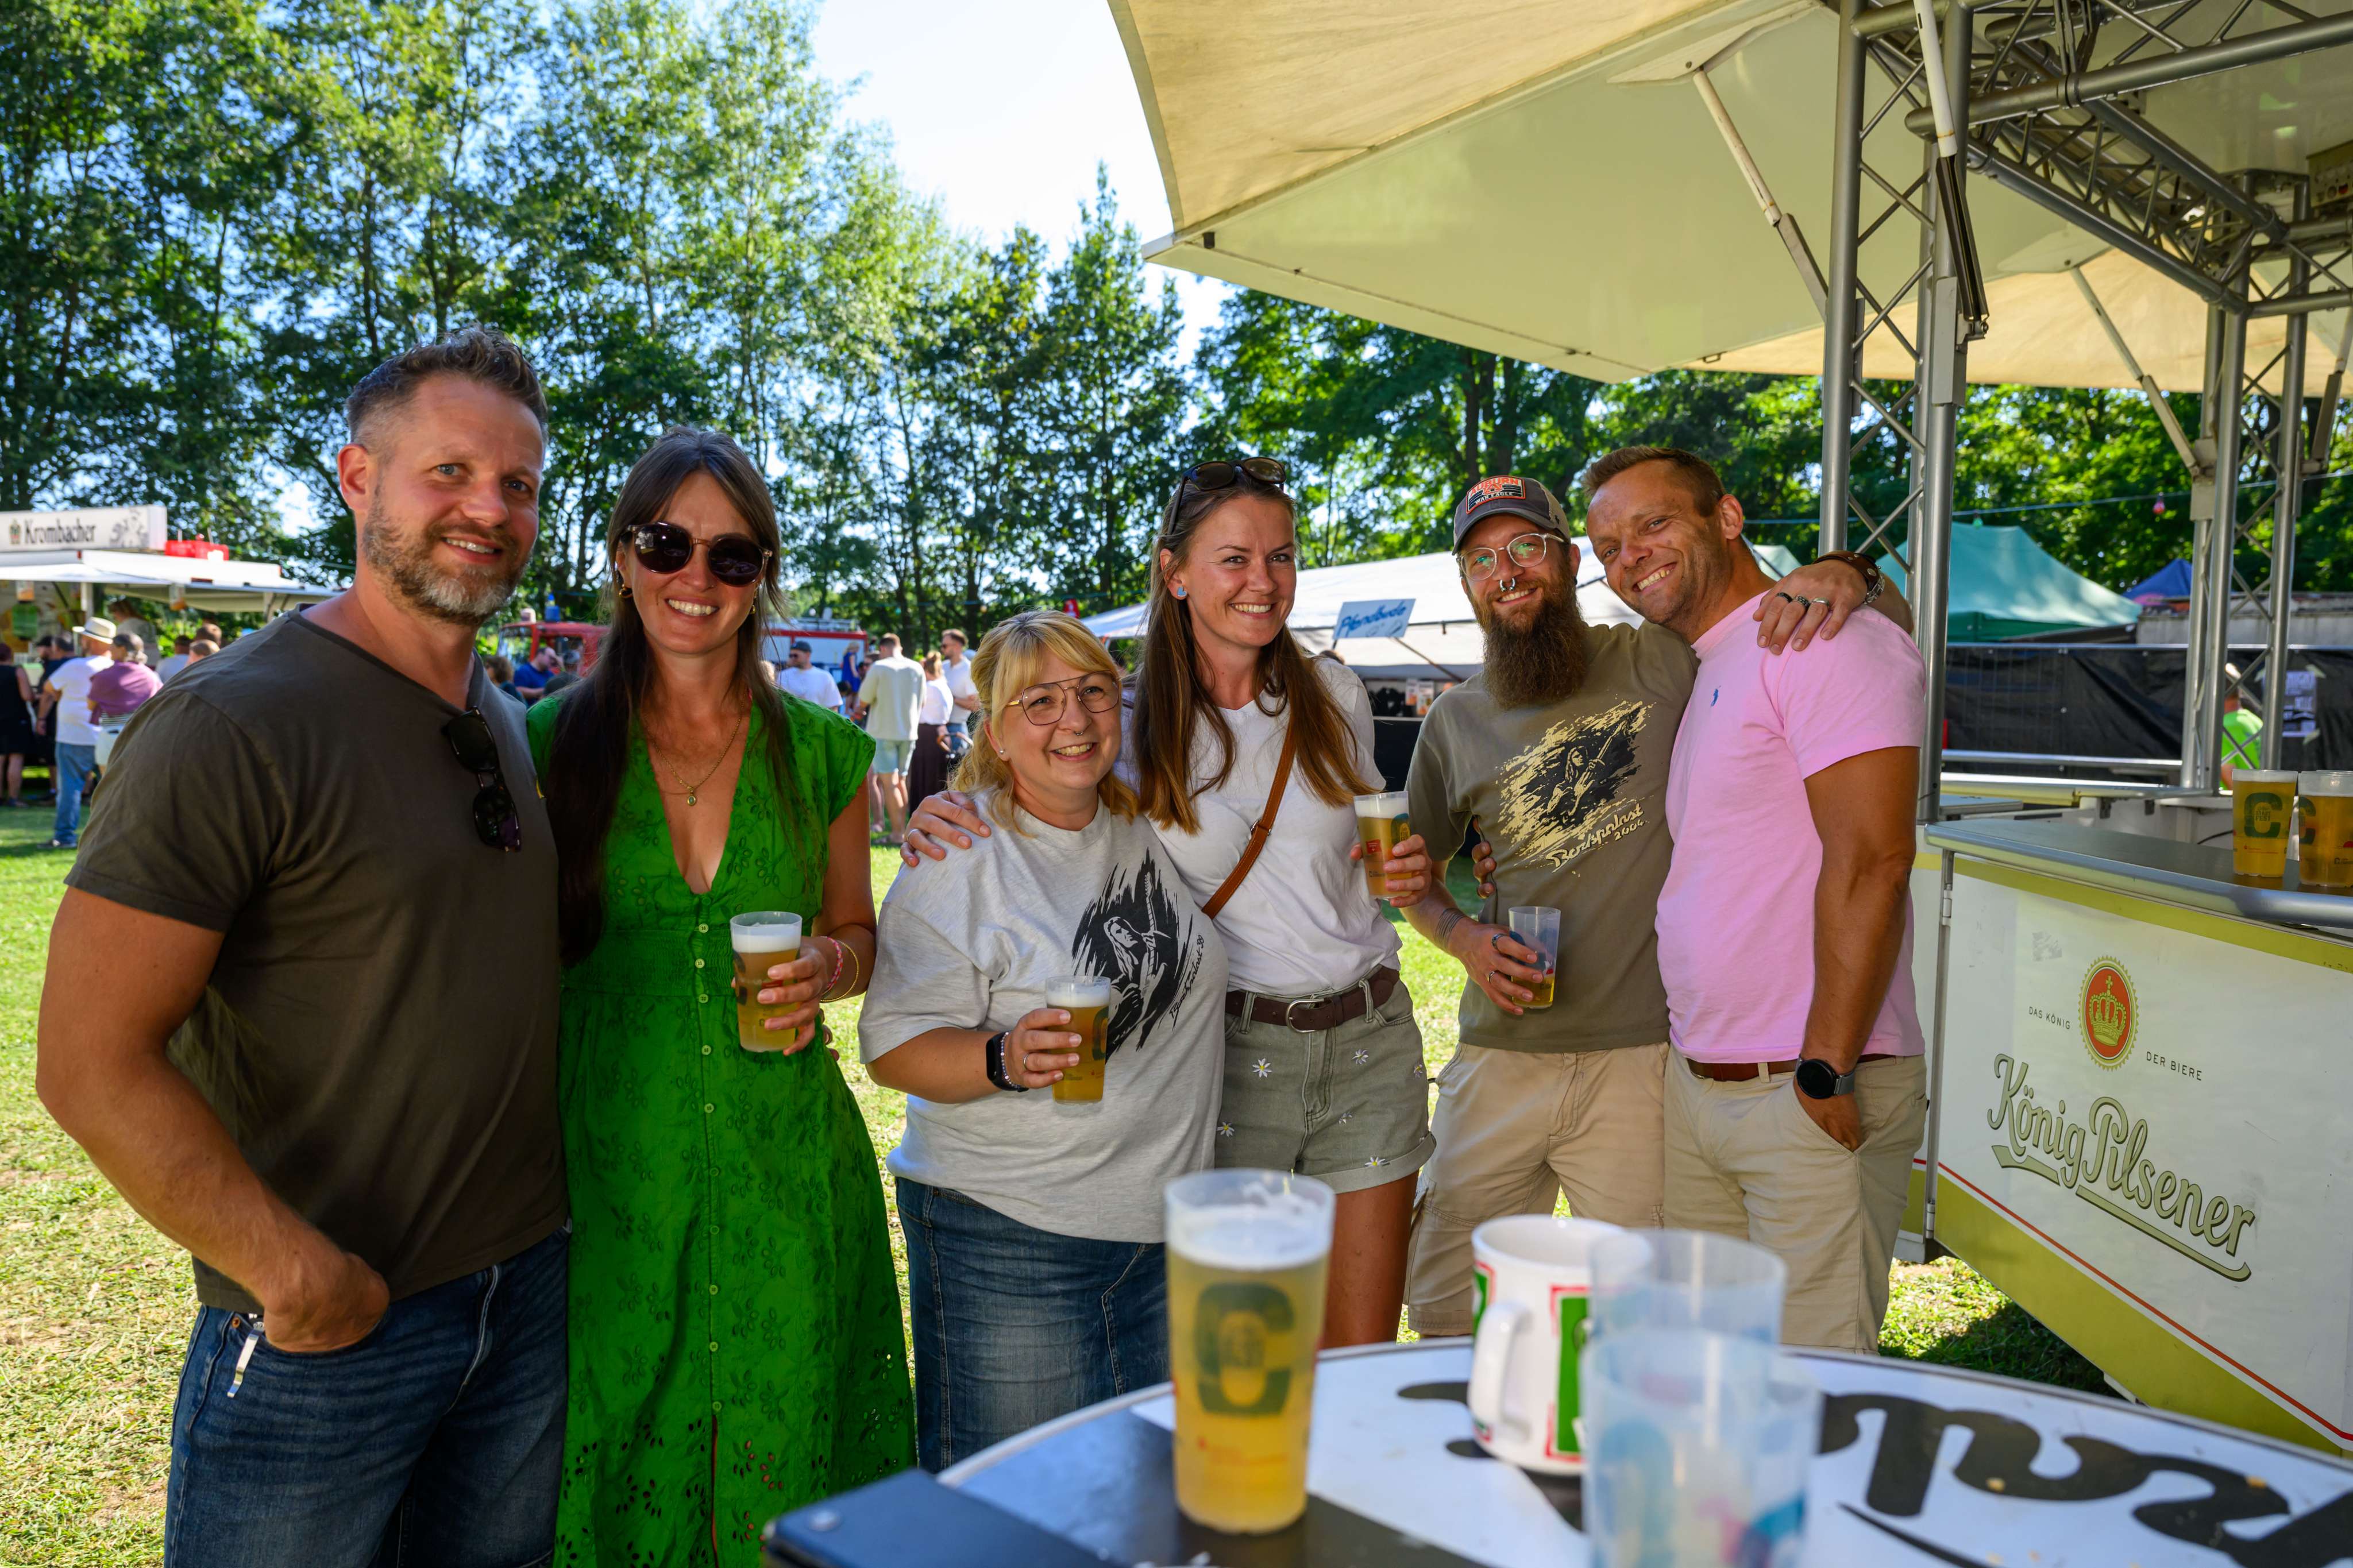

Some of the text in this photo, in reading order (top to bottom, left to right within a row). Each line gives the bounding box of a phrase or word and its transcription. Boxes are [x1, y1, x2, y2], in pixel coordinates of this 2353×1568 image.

[1470, 477, 1518, 497] AUBURN
[25, 518, 97, 544] Krombacher
[2028, 1006, 2071, 1030] DAS KÖNIG
[2146, 1051, 2202, 1081] DER BIERE
